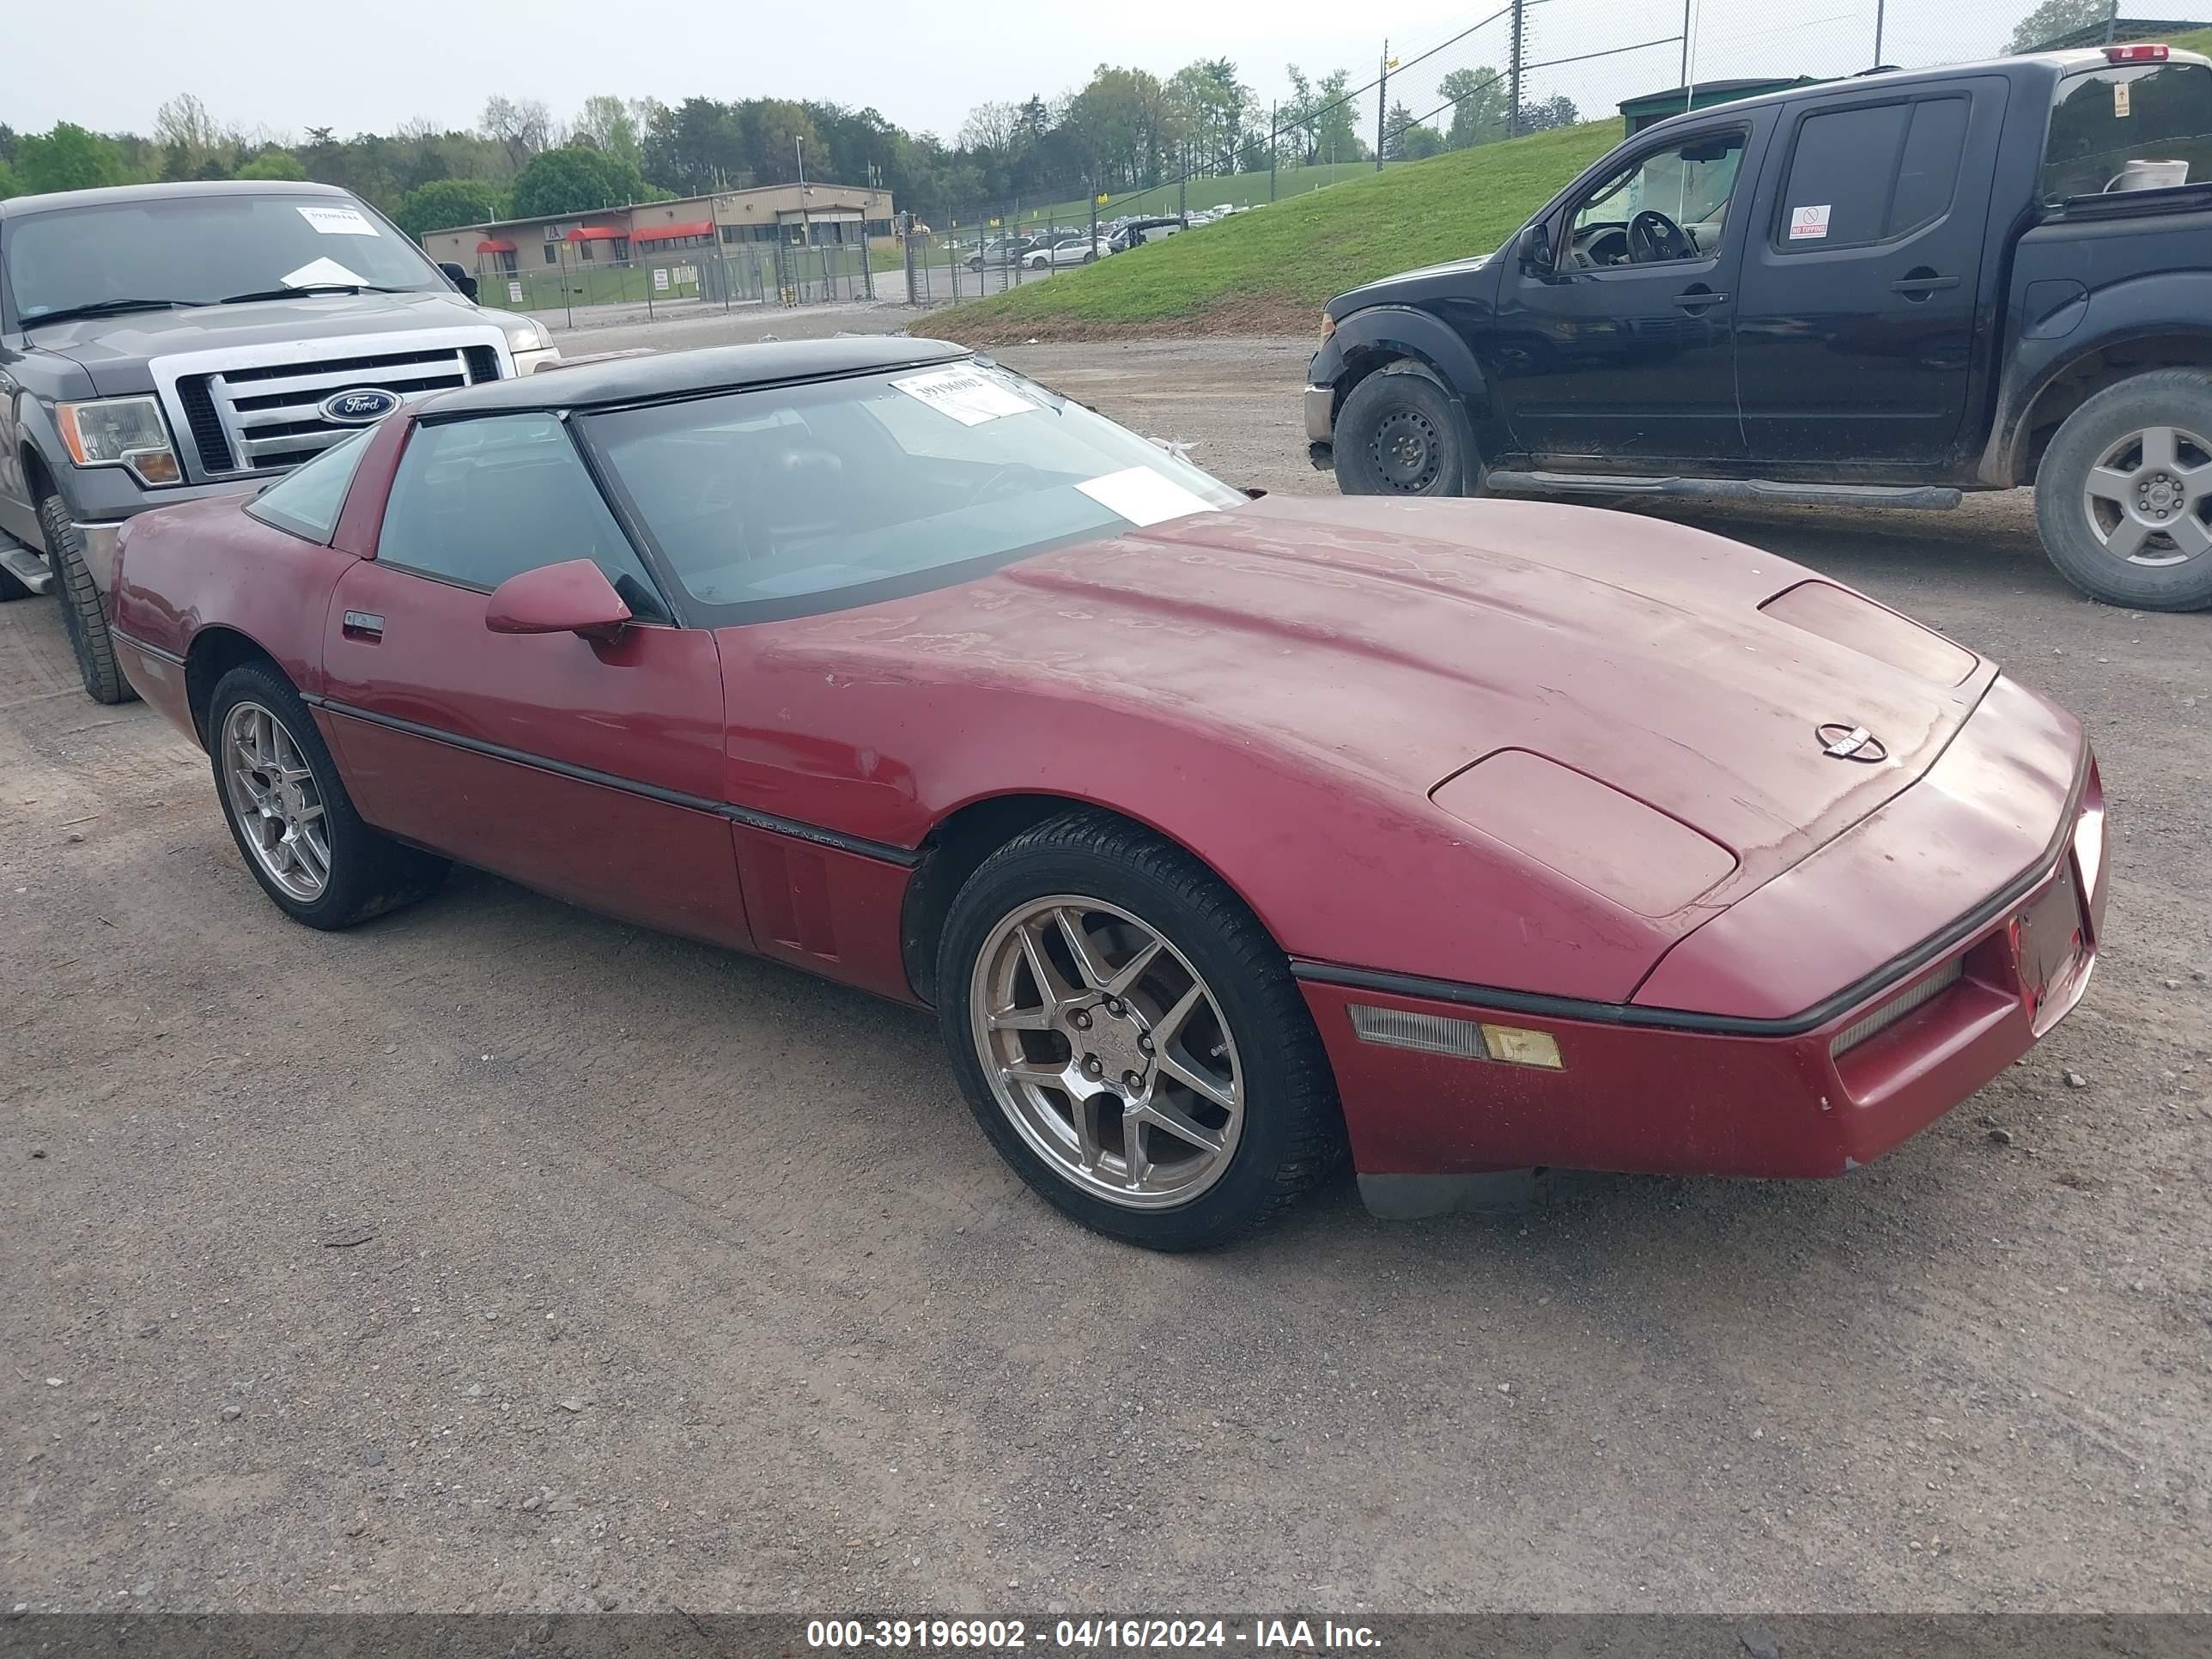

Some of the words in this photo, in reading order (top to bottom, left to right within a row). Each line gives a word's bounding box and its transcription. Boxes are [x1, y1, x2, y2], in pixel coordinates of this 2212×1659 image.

[915, 378, 983, 398] 39196902
[344, 396, 380, 413] Ford
[775, 825, 799, 836] PORT
[802, 830, 846, 848] NJECTION
